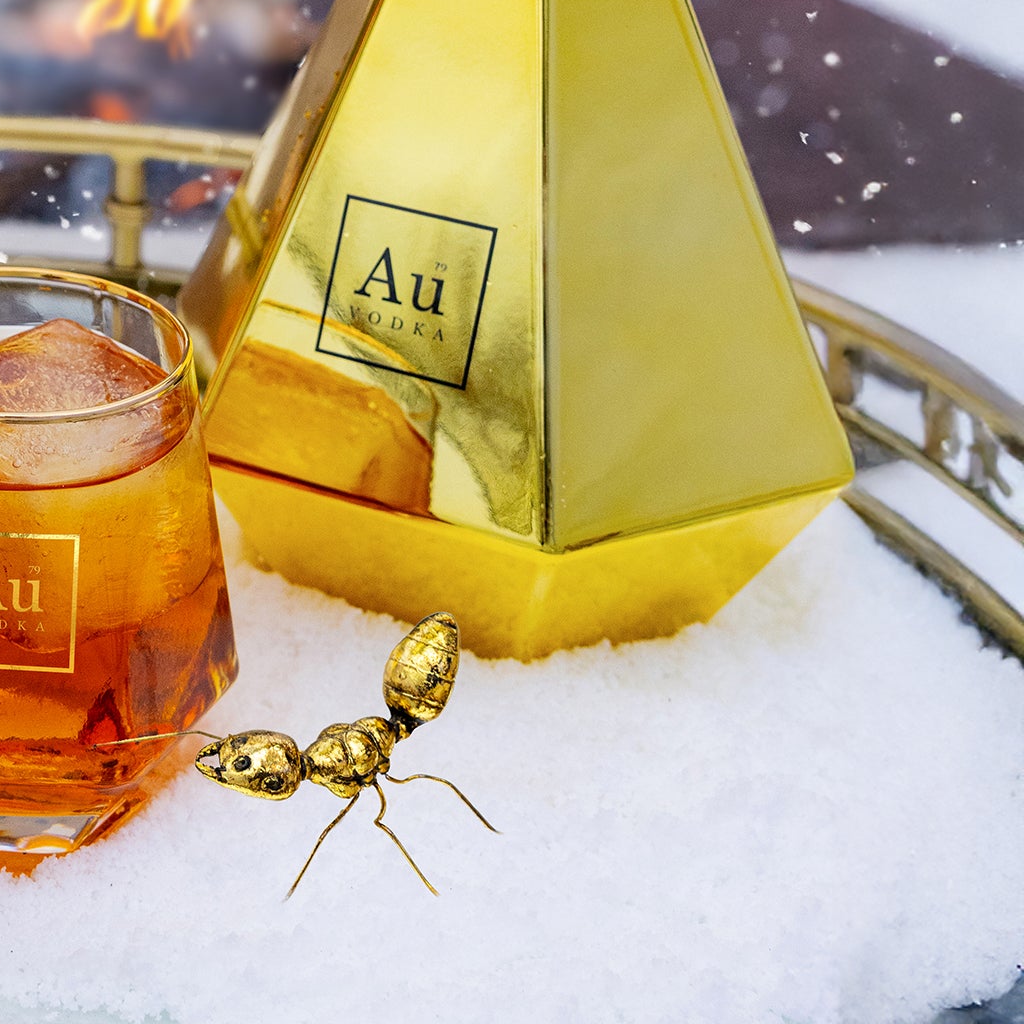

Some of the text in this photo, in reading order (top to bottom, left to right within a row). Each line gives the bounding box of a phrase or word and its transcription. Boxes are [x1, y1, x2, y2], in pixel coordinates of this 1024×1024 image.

[354, 247, 444, 316] Au
[349, 305, 443, 342] VODKA
[28, 565, 41, 574] 79
